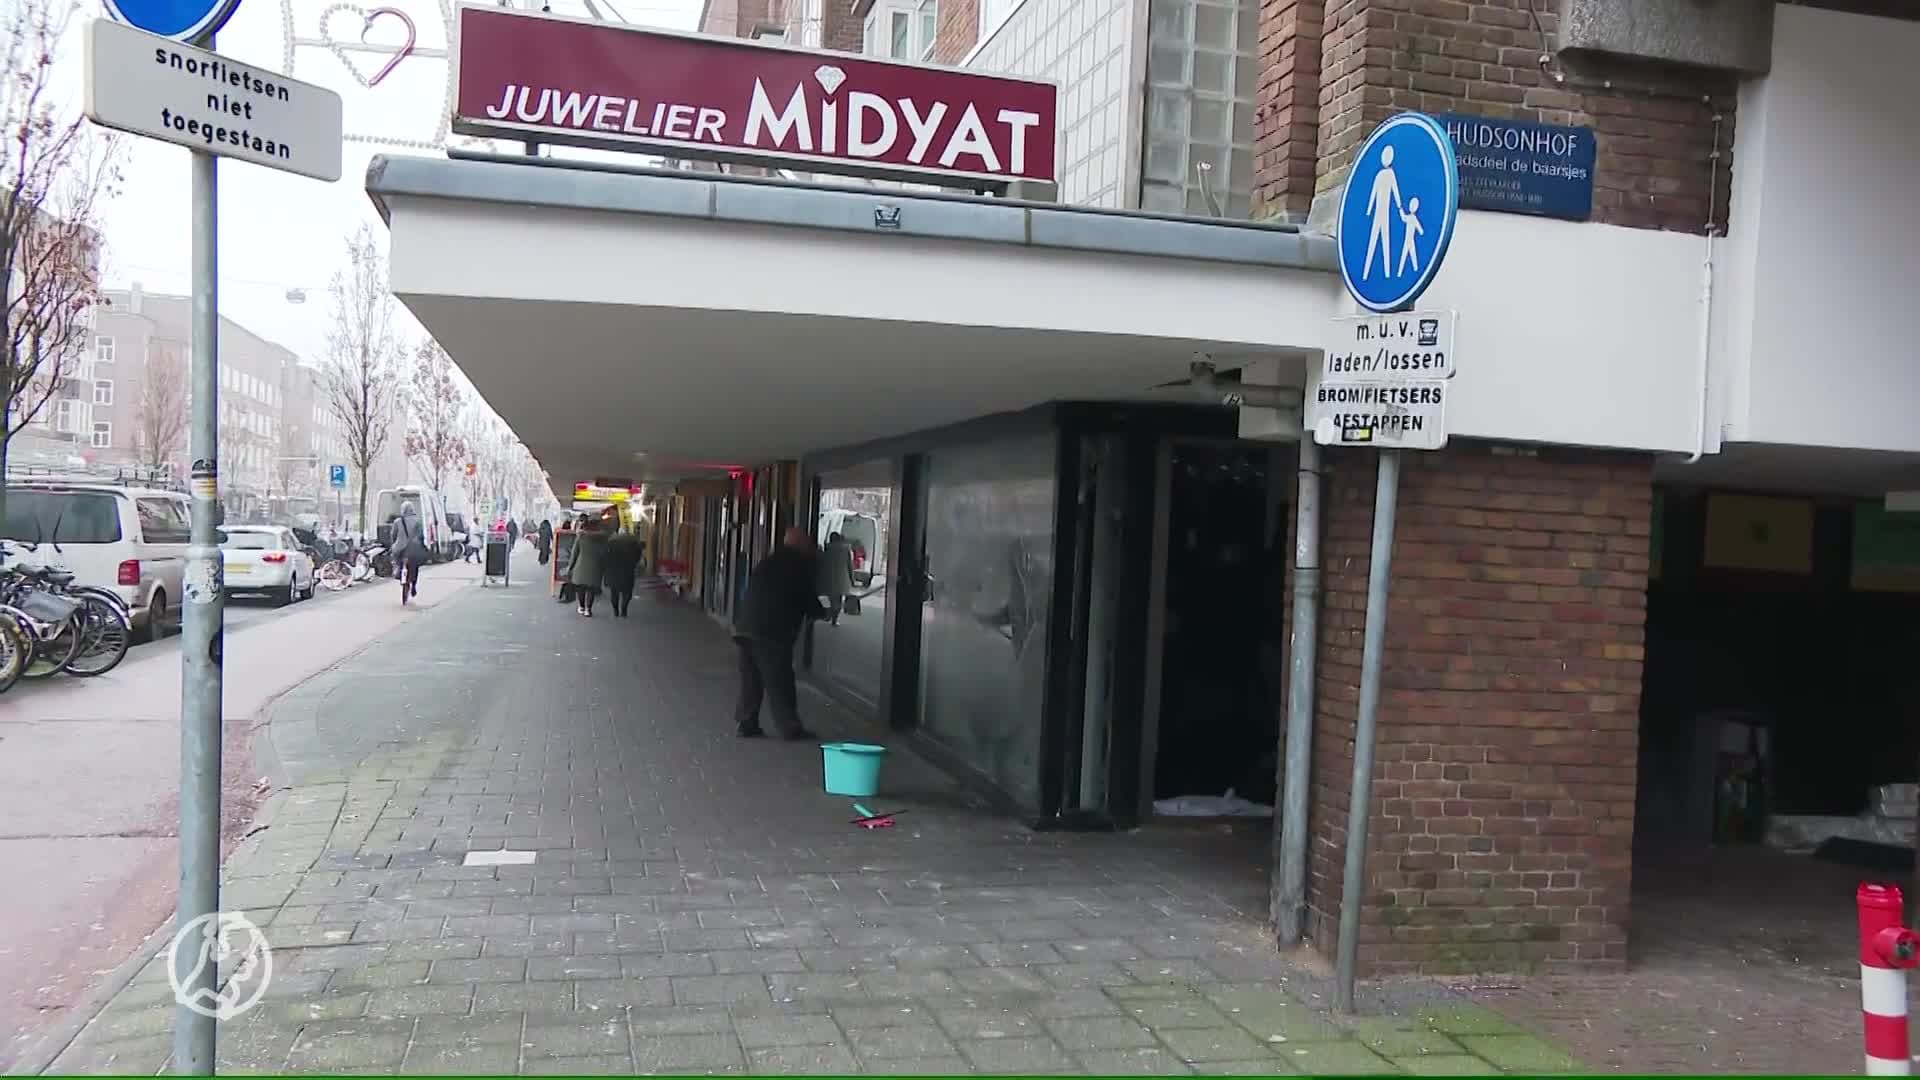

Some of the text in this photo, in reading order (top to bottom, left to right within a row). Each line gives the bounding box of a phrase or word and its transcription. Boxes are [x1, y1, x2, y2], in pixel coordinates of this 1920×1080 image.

[155, 47, 290, 102] snorfietsen
[207, 93, 253, 120] niet
[486, 83, 728, 144] JUWELIER
[161, 107, 291, 160] toegestaan
[1447, 120, 1578, 157] HUDSONHOF
[1455, 153, 1588, 180] adsdeel de baarsjes
[1328, 348, 1445, 374] laden/lossen
[1317, 387, 1442, 404] BROM/FIETSERS
